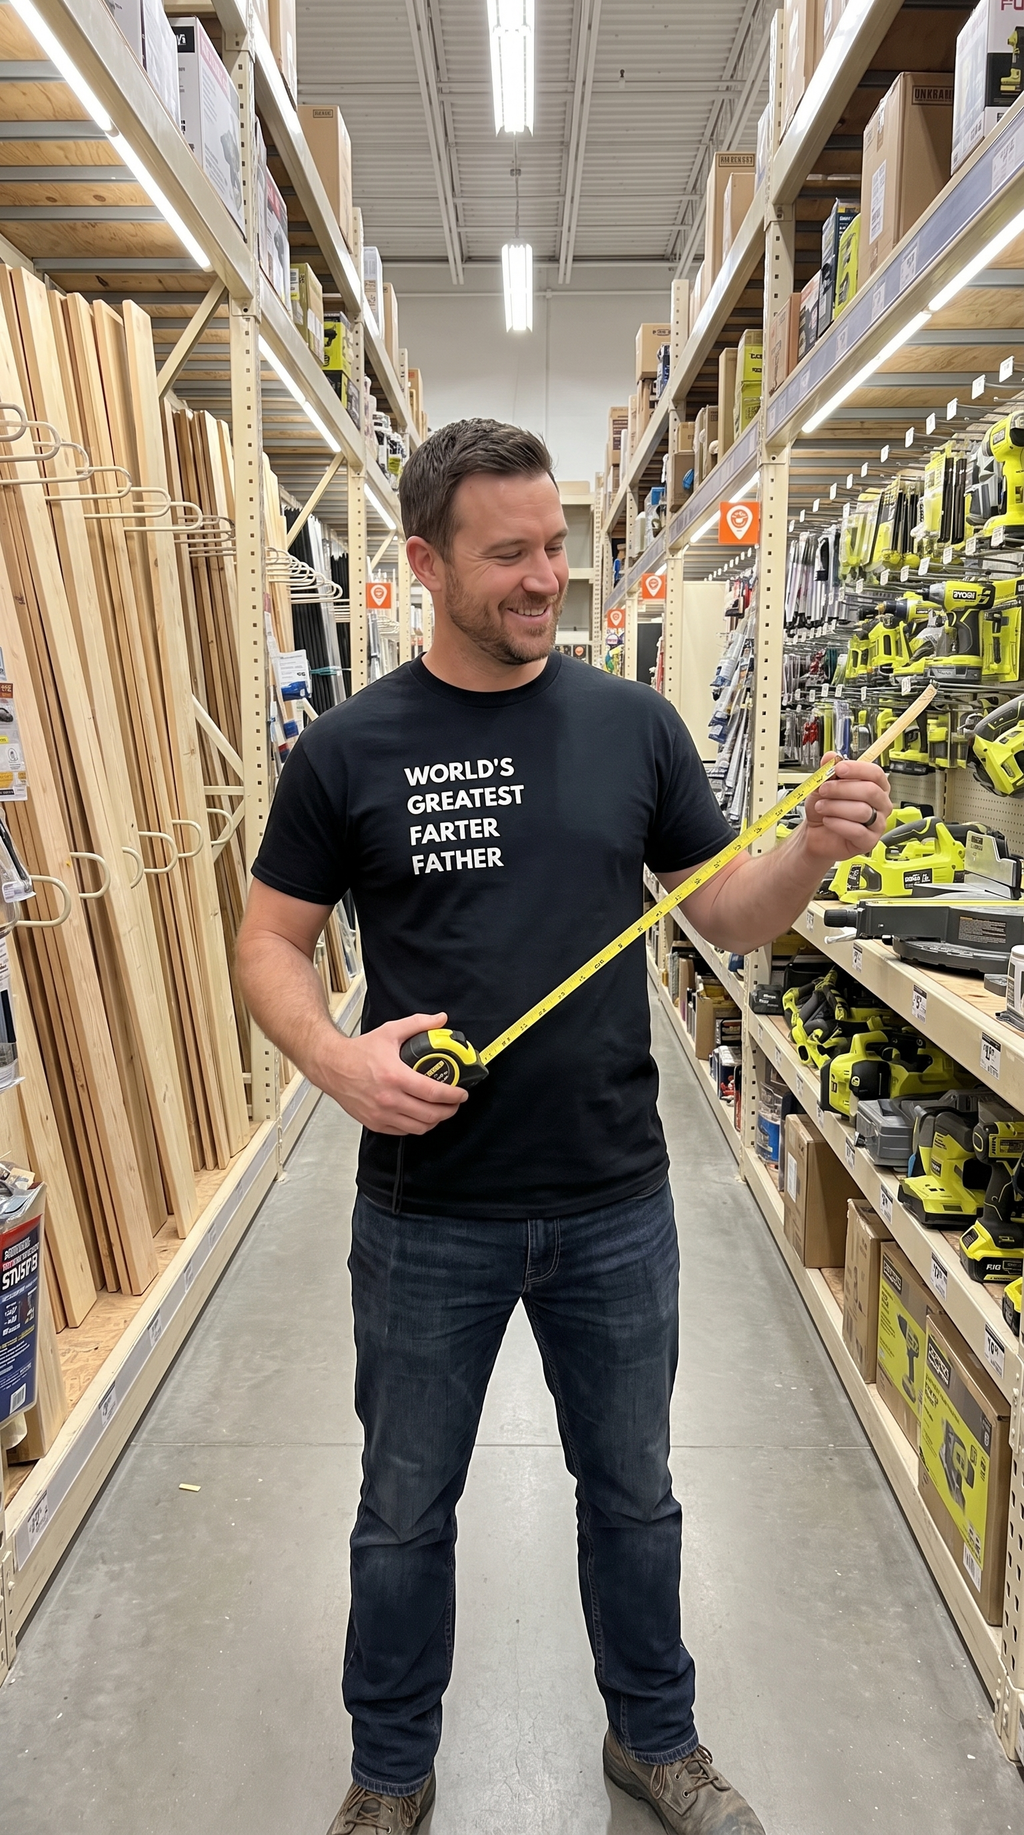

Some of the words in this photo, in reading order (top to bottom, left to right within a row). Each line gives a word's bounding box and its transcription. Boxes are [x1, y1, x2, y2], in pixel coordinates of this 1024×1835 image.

[404, 757, 515, 786] WORLD'S
[407, 784, 524, 815] GREATEST
[409, 817, 501, 846] FARTER
[411, 847, 504, 875] FATHER
